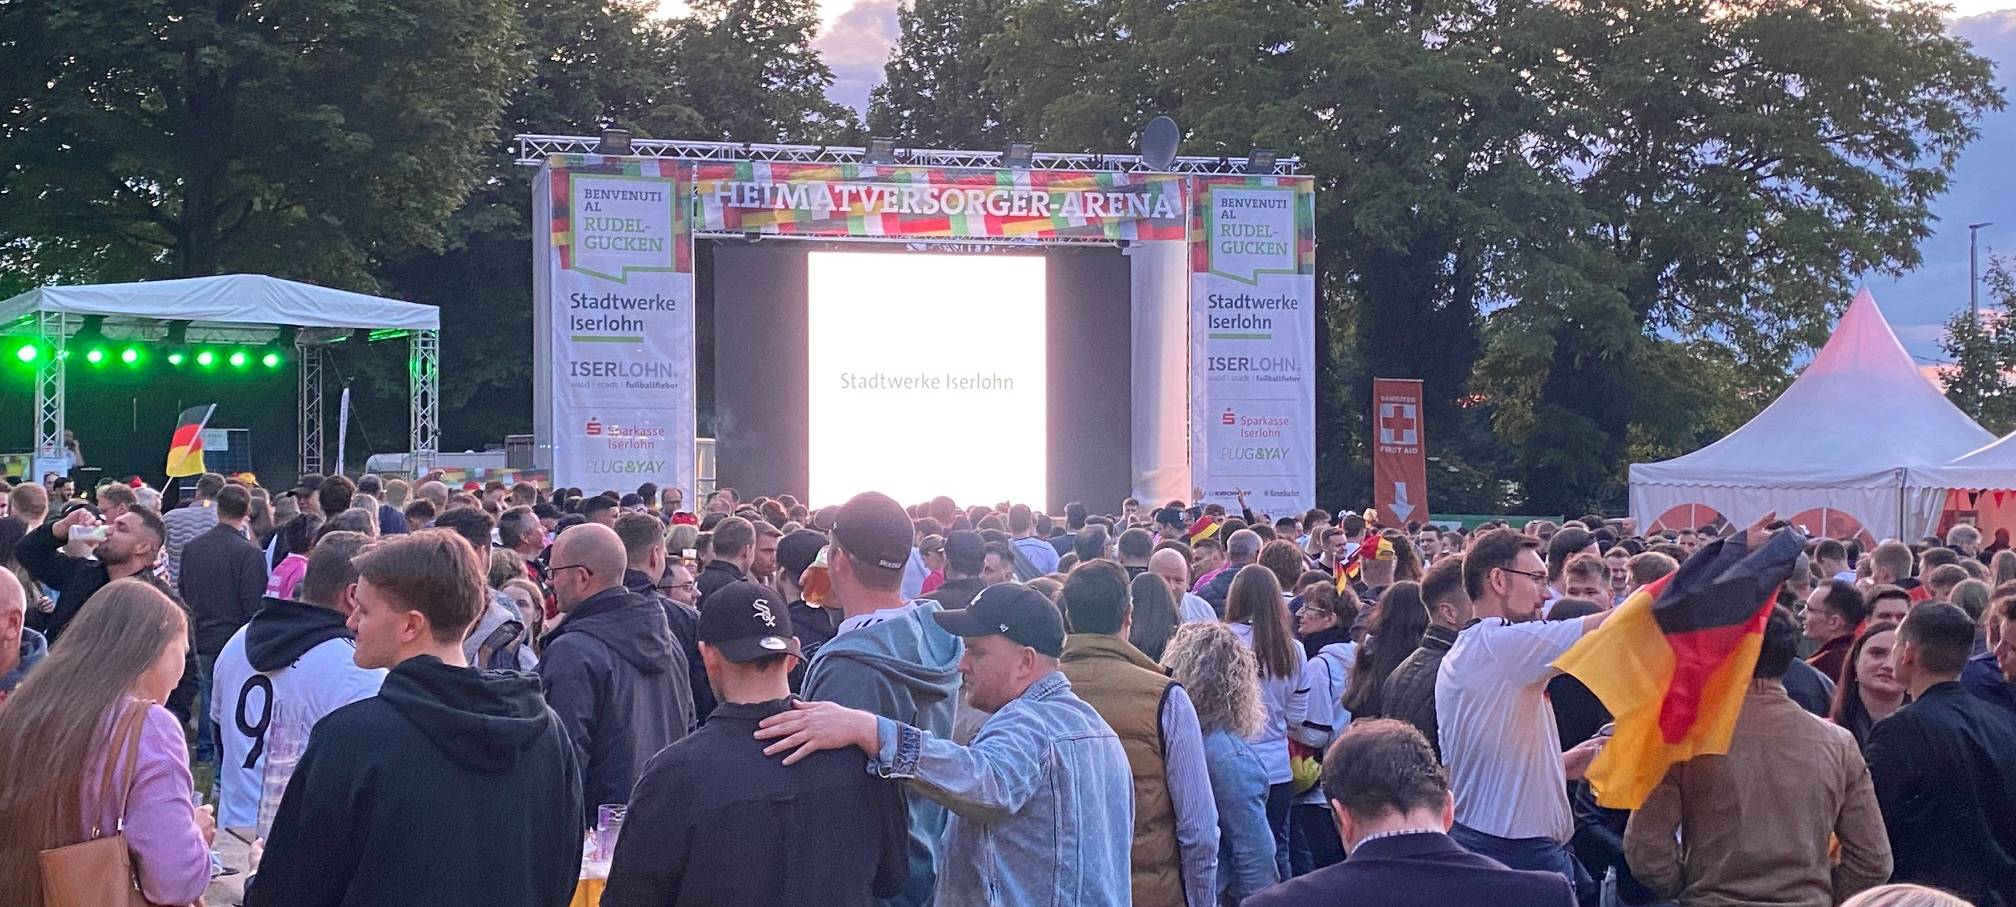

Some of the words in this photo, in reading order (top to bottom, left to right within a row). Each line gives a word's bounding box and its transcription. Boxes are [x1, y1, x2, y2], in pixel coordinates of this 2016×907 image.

[584, 188, 662, 202] BENVENUTI
[711, 180, 1177, 219] HEIMATVERSORGER-ARENA
[584, 202, 601, 212] AL
[1221, 198, 1287, 209] BENVENUTI
[1221, 209, 1236, 219] AL
[584, 216, 651, 233] RUDEL-
[1221, 223, 1278, 238] RUDEL-
[584, 235, 664, 252] GUCKEN
[1221, 241, 1288, 255] GUCKEN
[570, 292, 676, 311] Stadtwerke
[1208, 294, 1298, 310] Stadtwerke
[570, 314, 644, 332] Iserlohn
[1208, 313, 1272, 329] Iserlohn
[840, 372, 940, 390] Stadtwerke
[946, 372, 1014, 390] Iserlohn
[1240, 415, 1289, 427] Sparkasse
[608, 426, 665, 439] Sparkasse
[1240, 428, 1281, 438] Iserlohn
[608, 438, 655, 449] Iserlohn
[1380, 445, 1402, 454] FIRST
[1221, 447, 1290, 460] PLUG&YAY
[585, 460, 665, 474] PLUG&YAY
[235, 674, 274, 770] 9
